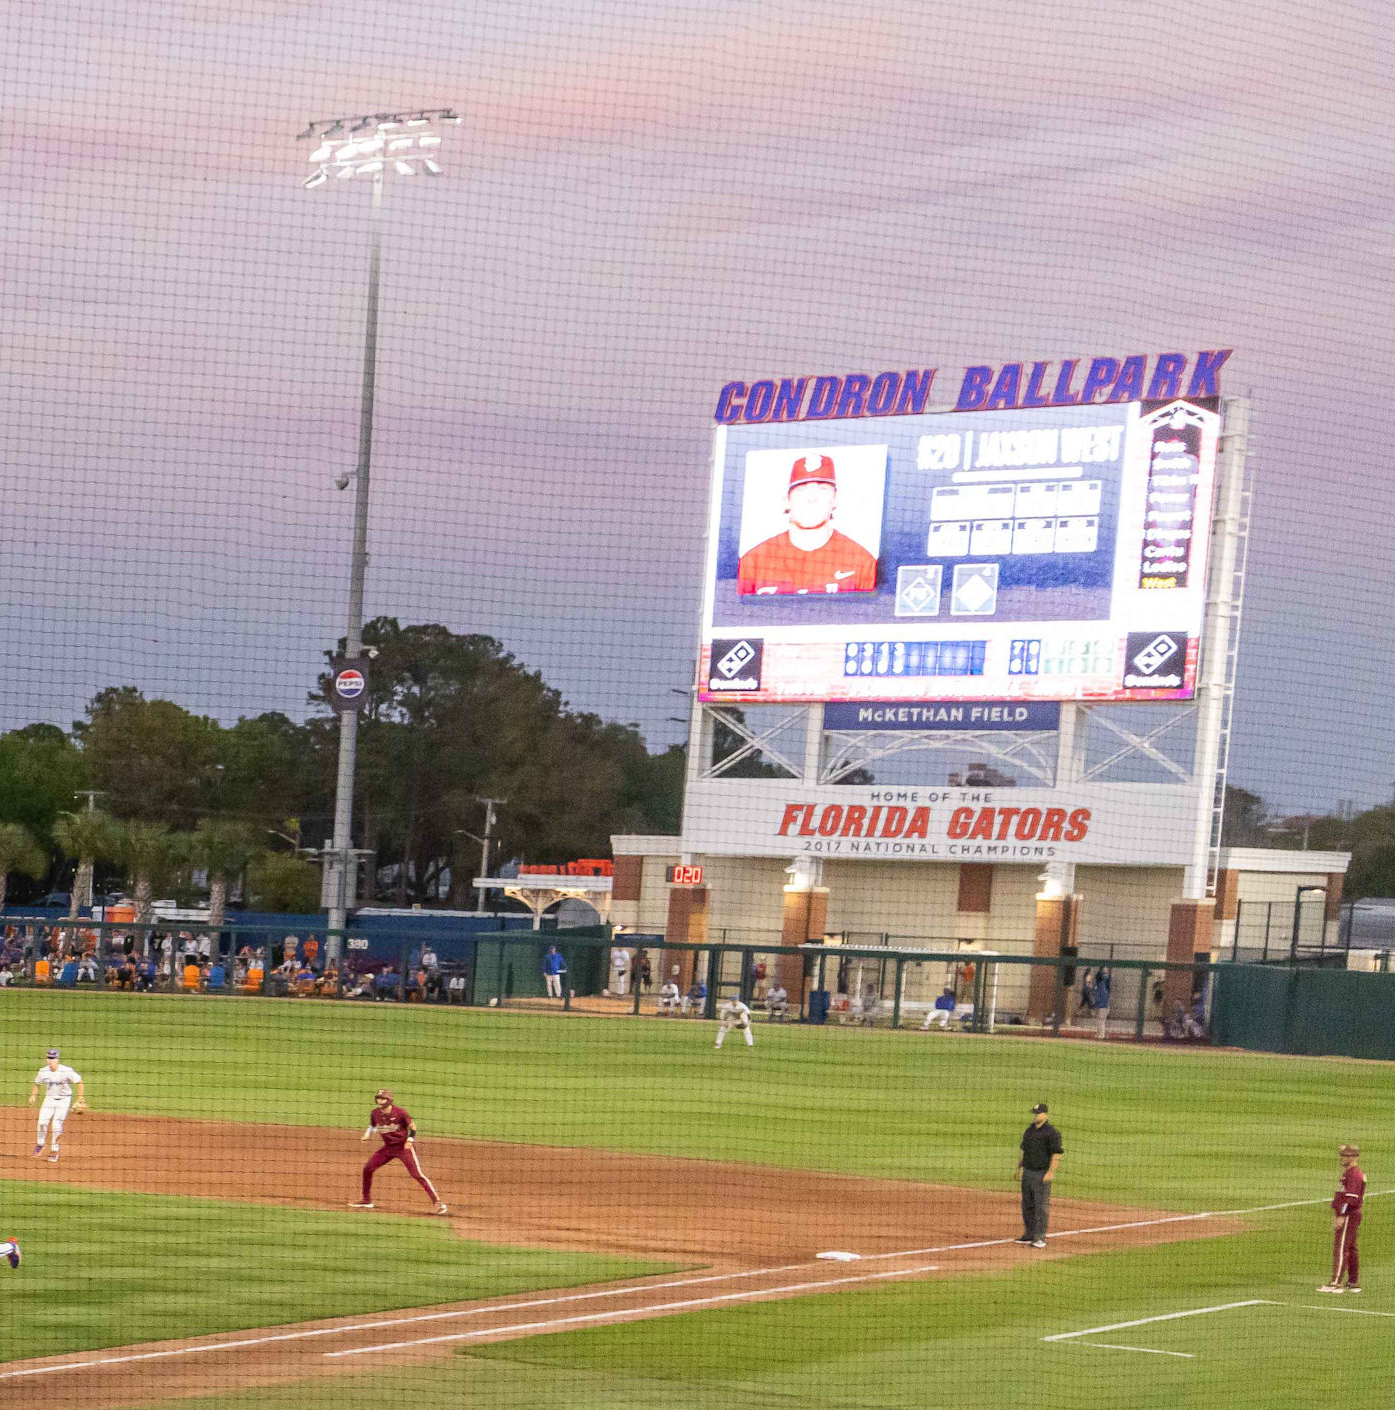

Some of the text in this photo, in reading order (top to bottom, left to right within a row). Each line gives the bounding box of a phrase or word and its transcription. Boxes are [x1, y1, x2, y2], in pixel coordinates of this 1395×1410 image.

[714, 349, 1233, 425] CONDRON BALLPARK
[1061, 425, 1125, 463] WEST
[858, 706, 1028, 722] McKETHAN FIELD
[871, 792, 993, 802] HOME OF THE
[778, 803, 1091, 842] FLORIDA GATORS
[804, 841, 1056, 857] 2017 NATIONAL CHAMPIONS
[674, 866, 702, 884] 020
